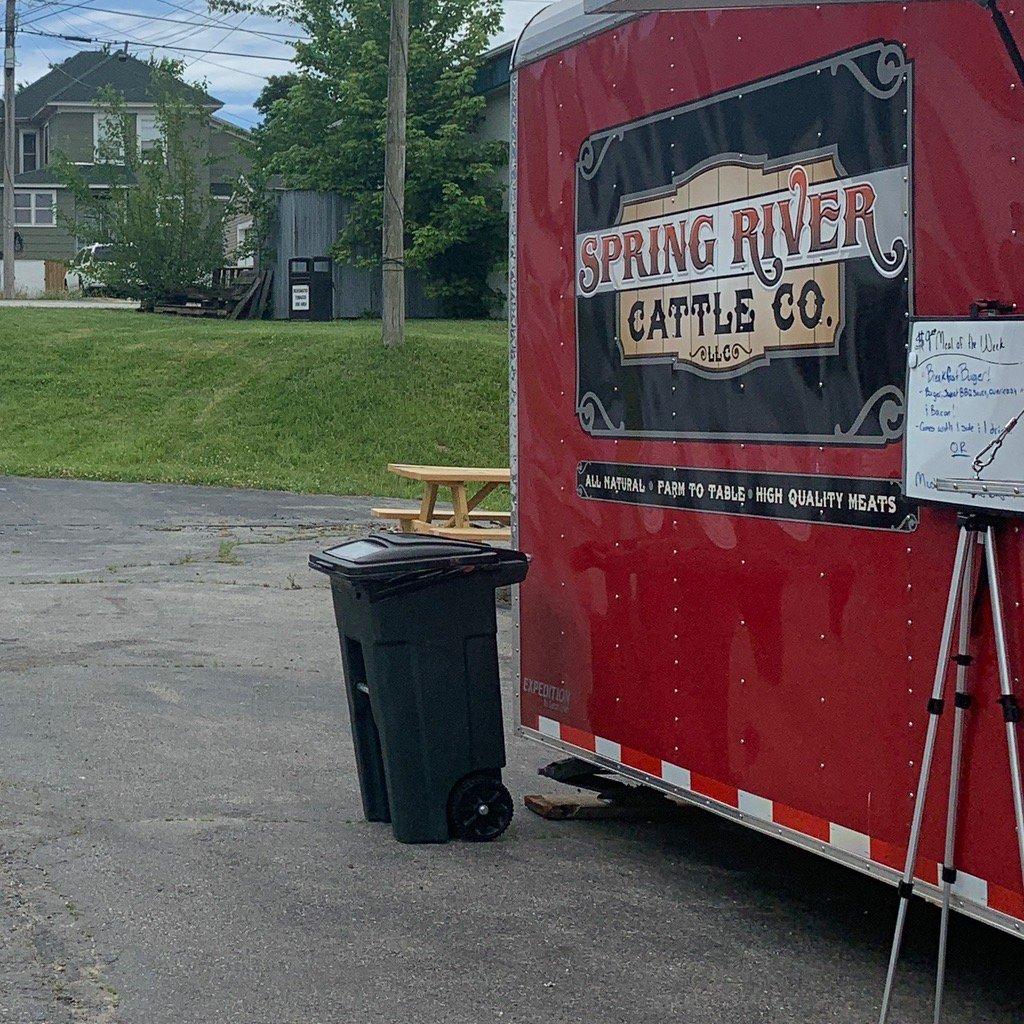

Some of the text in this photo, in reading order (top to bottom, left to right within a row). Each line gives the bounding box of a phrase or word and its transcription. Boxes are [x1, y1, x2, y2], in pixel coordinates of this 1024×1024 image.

[579, 167, 906, 294] SPRING RIVER
[628, 279, 833, 342] CATTLE CO.
[707, 344, 732, 363] LLC
[936, 330, 953, 351] Meal
[956, 336, 963, 350] of
[968, 333, 977, 350] the
[980, 333, 1006, 353] Week
[949, 441, 967, 454] OR
[585, 474, 897, 514] ALL NATURAL FARM TO TABLE HIGH QUALITY MEATS
[523, 677, 571, 703] EXPEDITION
